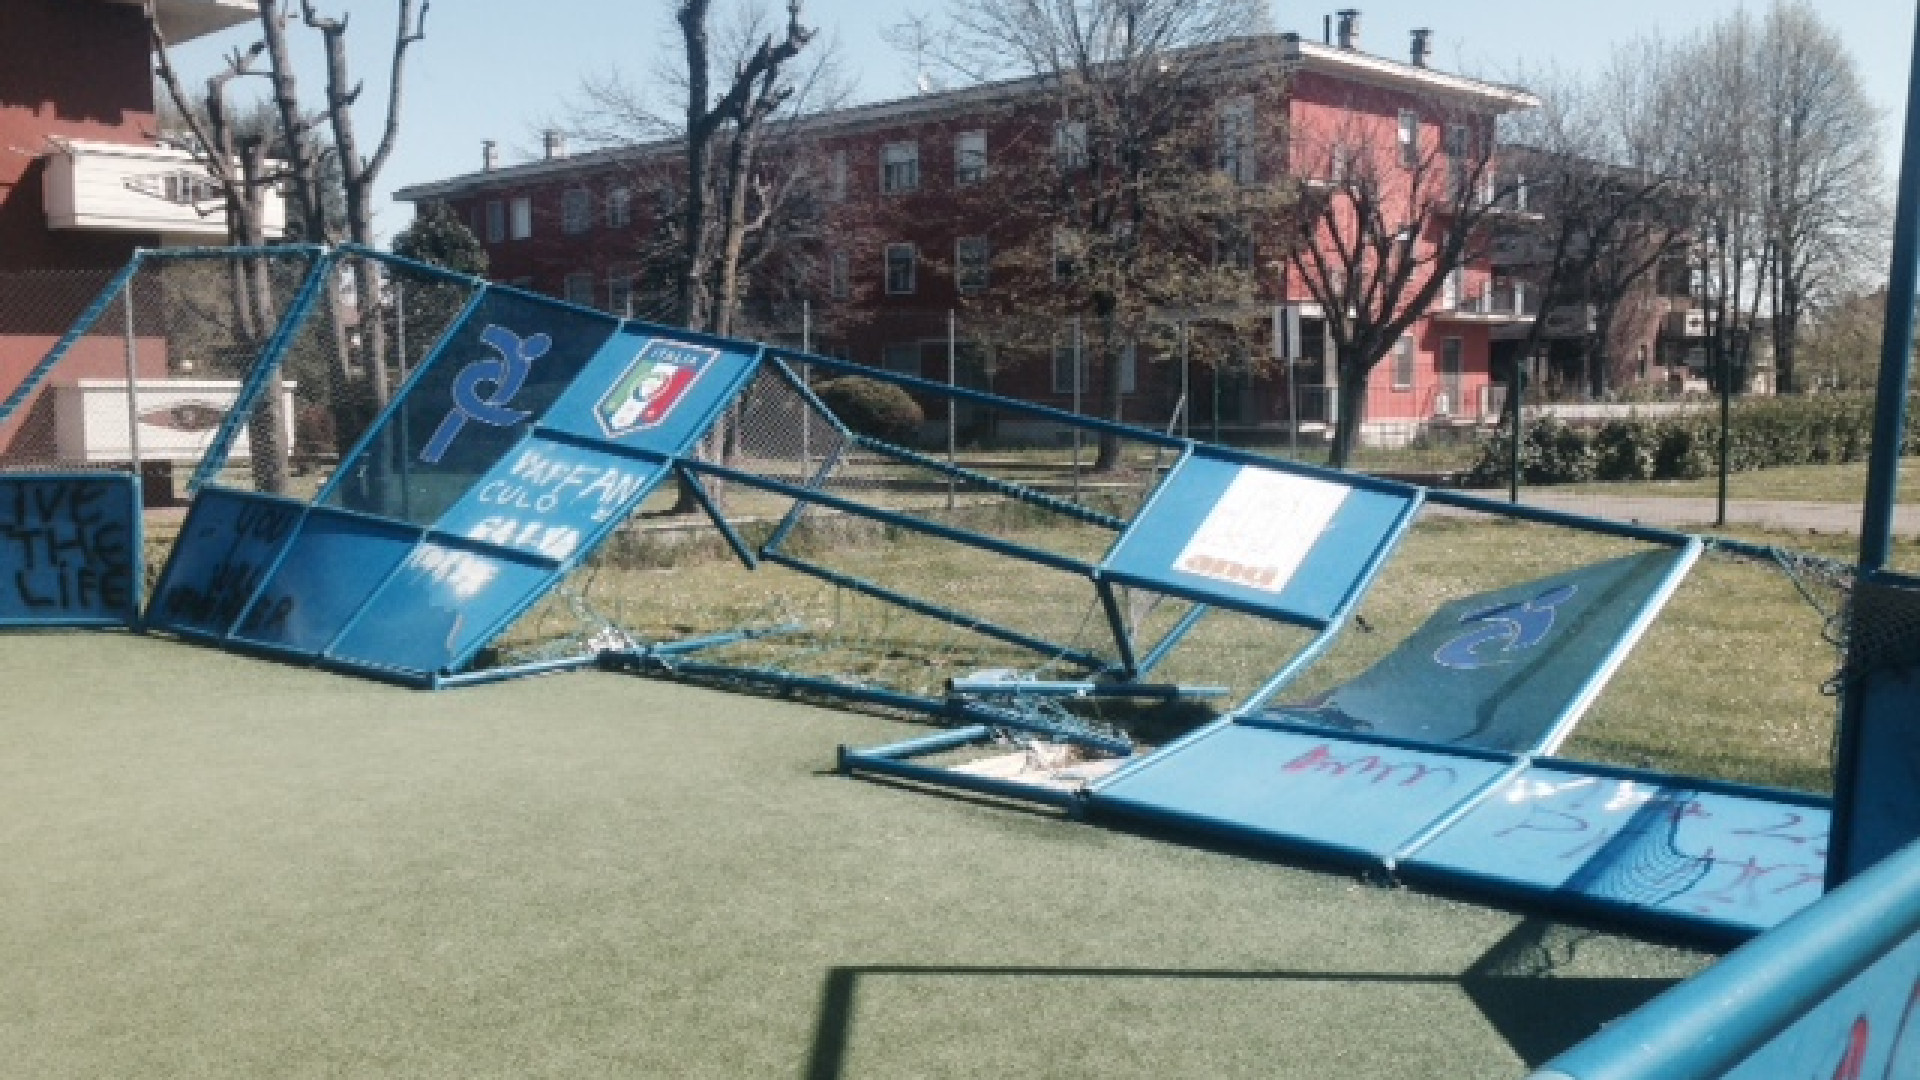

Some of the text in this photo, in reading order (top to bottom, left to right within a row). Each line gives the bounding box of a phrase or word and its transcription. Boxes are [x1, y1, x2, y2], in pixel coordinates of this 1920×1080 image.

[650, 345, 700, 365] ITALIA
[478, 479, 561, 513] CULO
[0, 523, 125, 570] THE
[15, 561, 129, 609] LIFE
